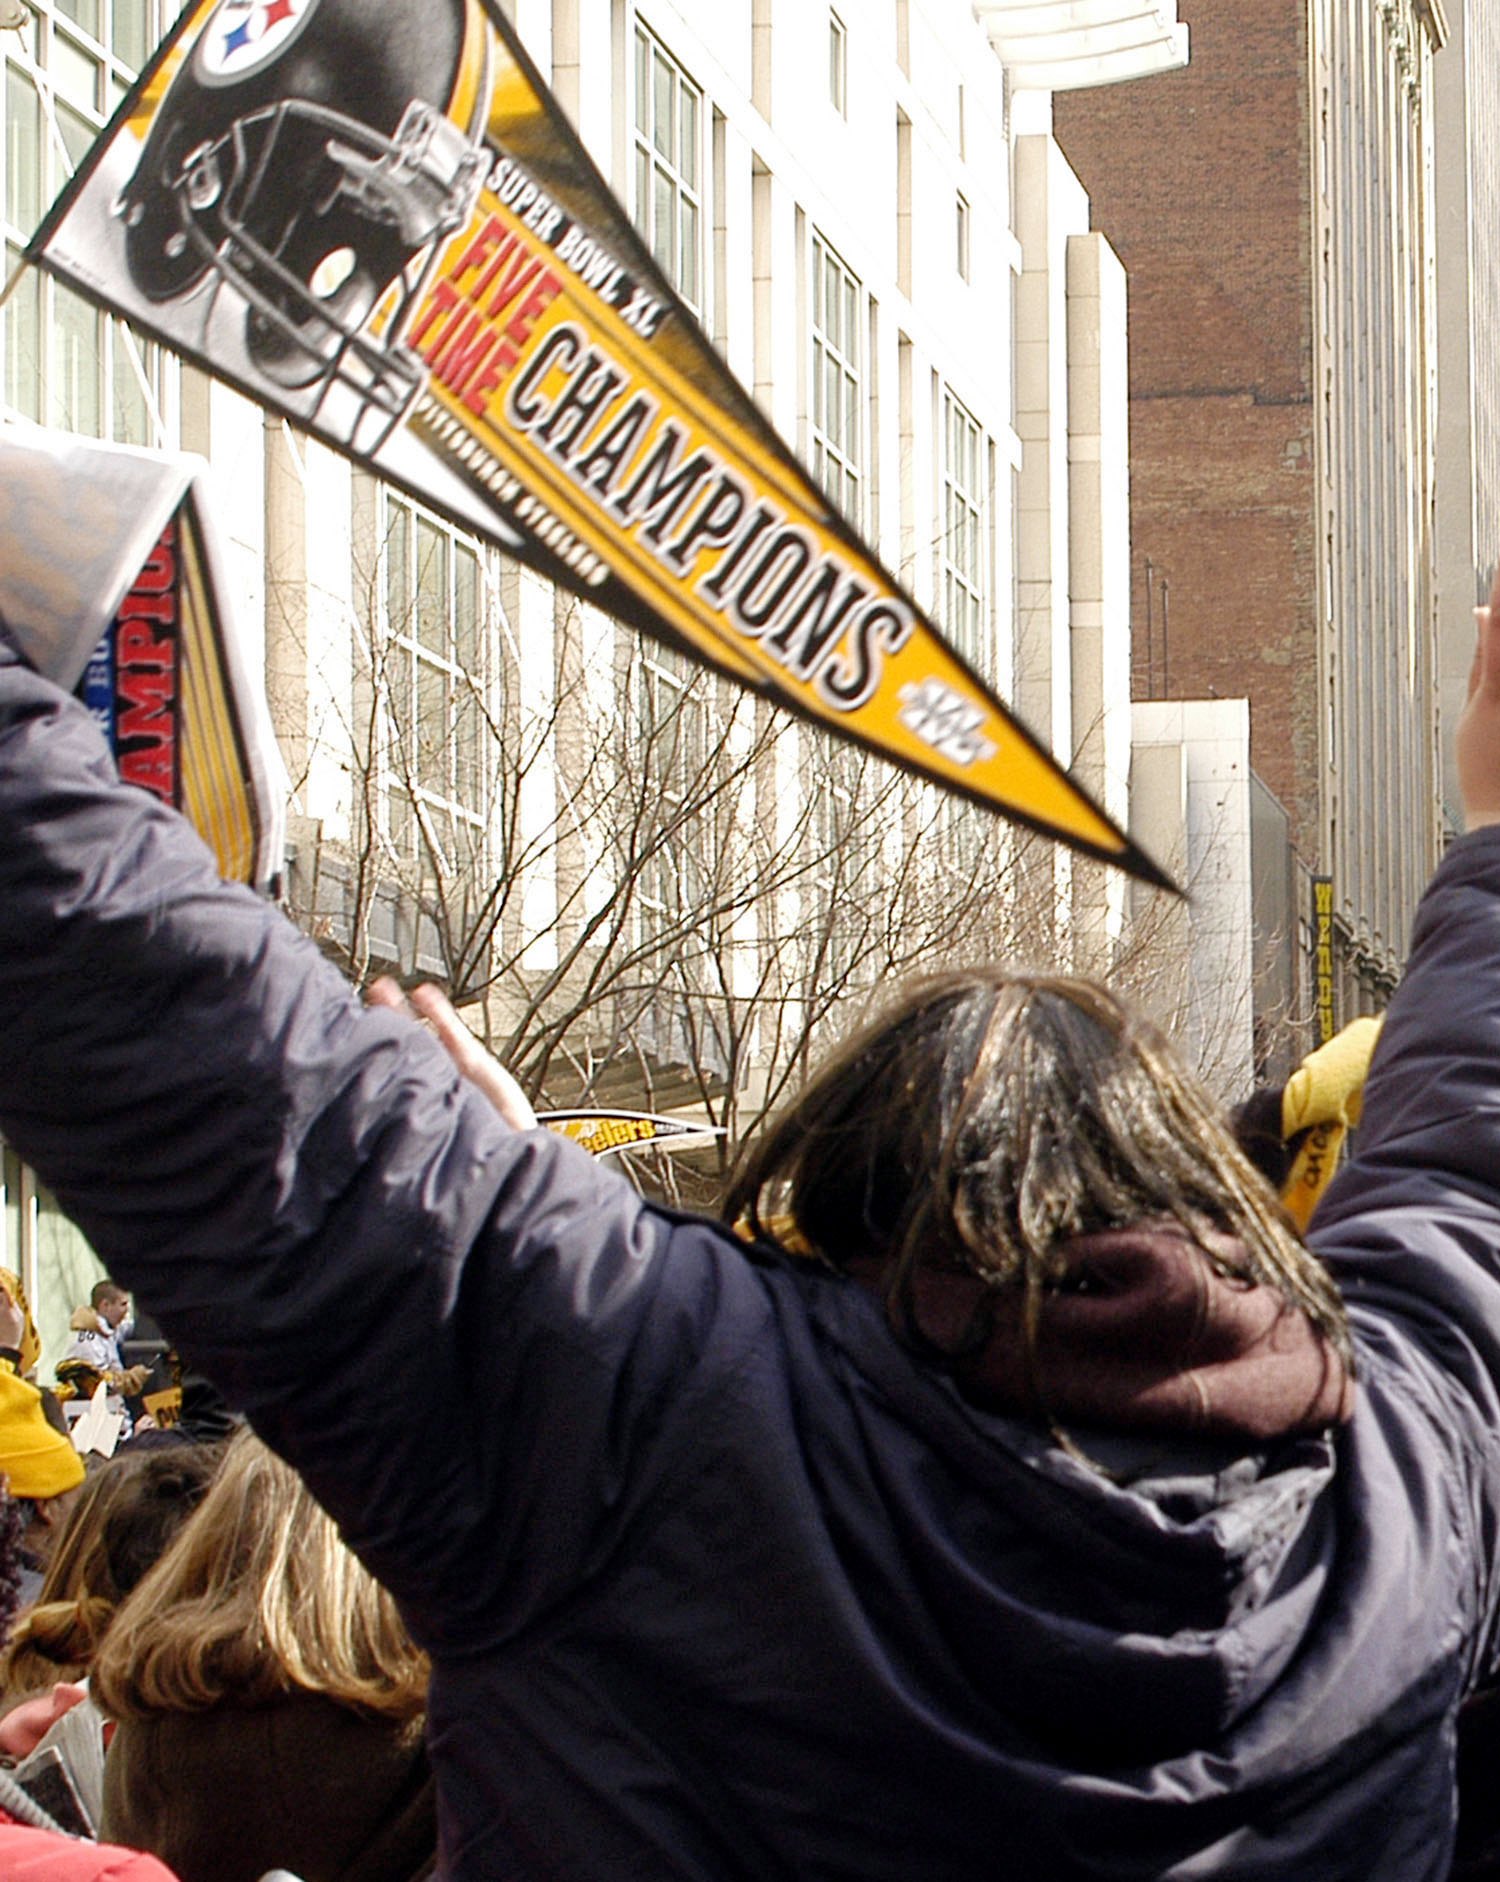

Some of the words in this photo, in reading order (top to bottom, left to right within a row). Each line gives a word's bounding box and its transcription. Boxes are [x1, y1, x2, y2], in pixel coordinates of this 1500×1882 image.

[450, 211, 564, 347] FIVE
[486, 157, 565, 243] SUPER
[553, 223, 626, 303] BOWL
[618, 286, 663, 339] XL
[406, 275, 520, 418] TIME
[506, 322, 914, 711] CHAMPIONS
[116, 522, 175, 806] AMPIO
